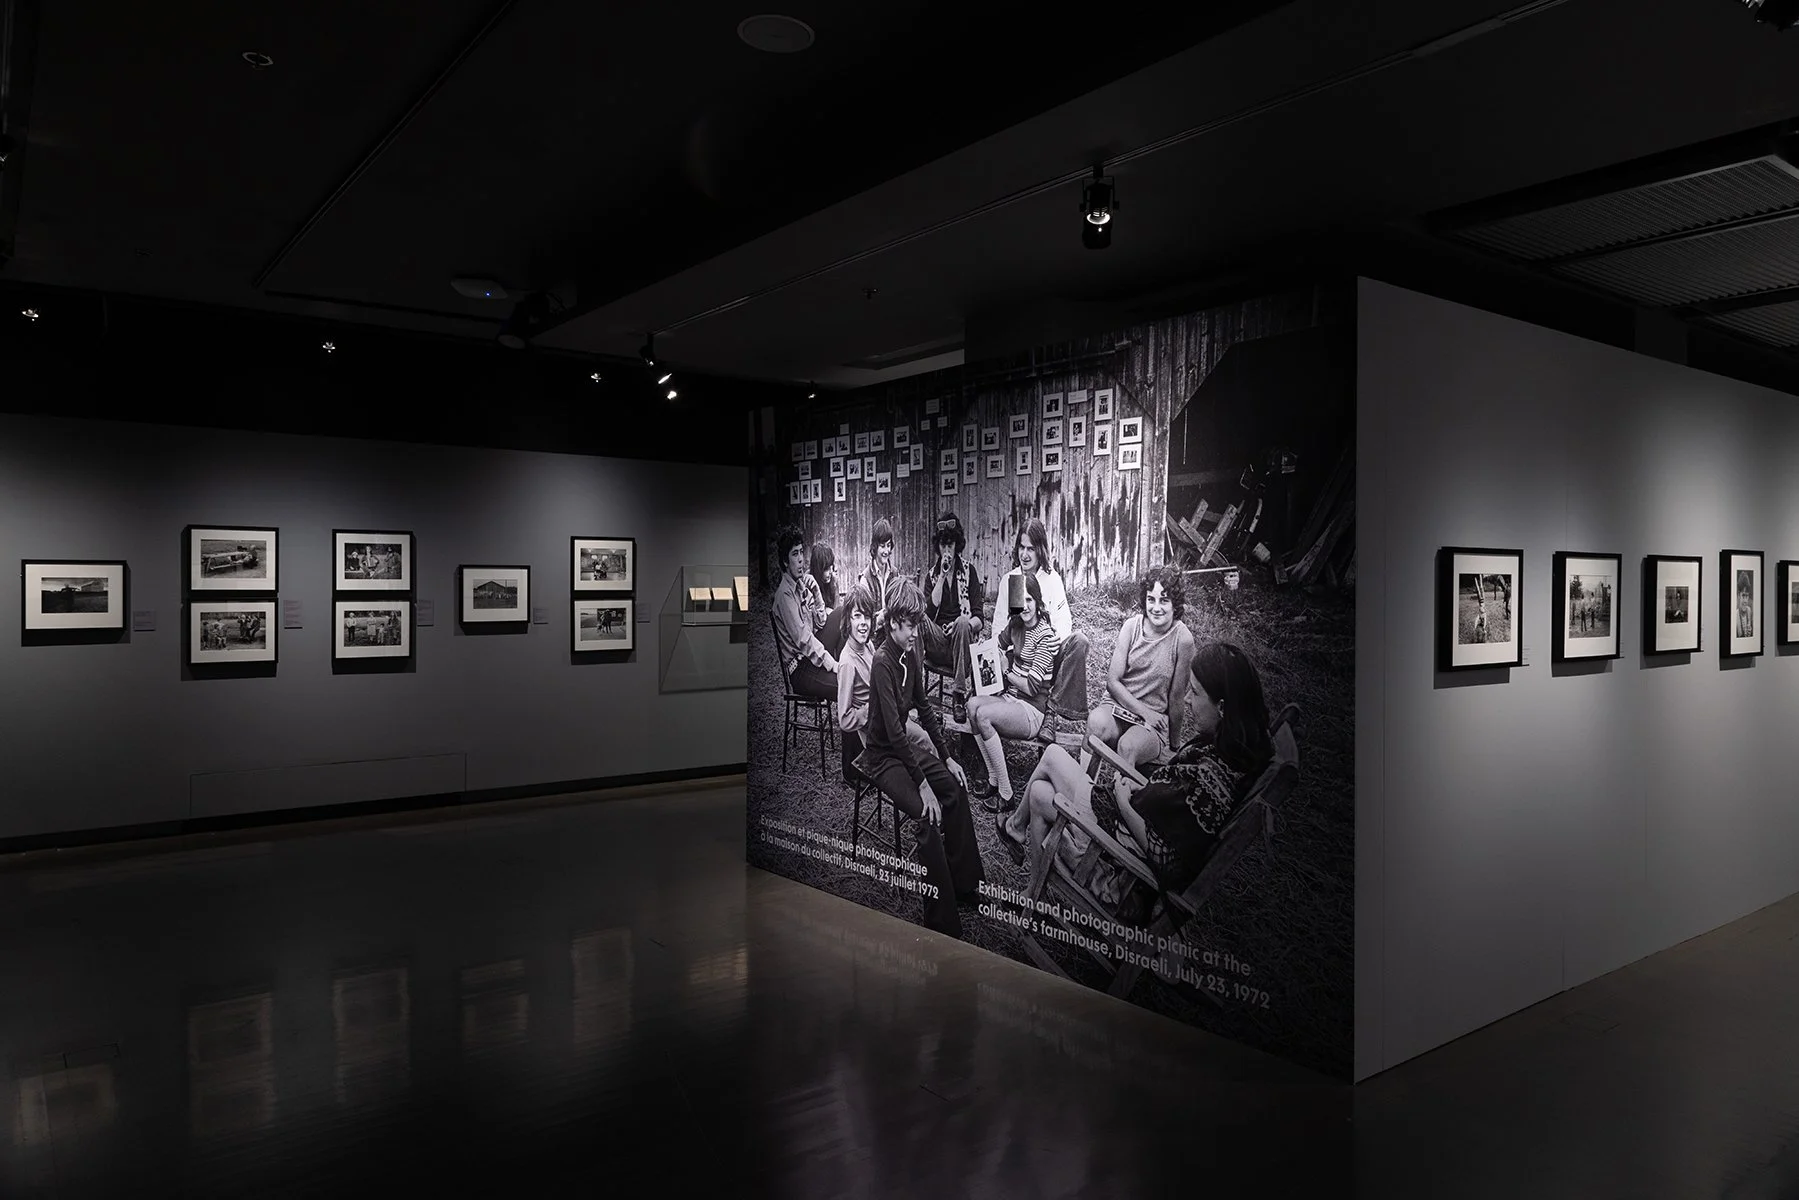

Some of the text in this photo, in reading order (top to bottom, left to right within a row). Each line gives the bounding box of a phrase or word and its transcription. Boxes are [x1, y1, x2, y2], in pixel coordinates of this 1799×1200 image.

[766, 832, 774, 844] la
[774, 836, 801, 853] maison
[801, 843, 811, 856] du
[811, 848, 844, 869] collectif,
[844, 855, 878, 880] Disraeli,
[879, 868, 890, 883] 23
[890, 871, 917, 892] juillet
[917, 881, 940, 900] 1972
[797, 826, 806, 838] et
[806, 829, 854, 853] pique-nique
[855, 843, 929, 877] photographique
[978, 879, 1251, 977] Exhibition and photographic picnic at the
[978, 903, 1270, 1010] collective's farmhouse, Disraeli, July 23, 1972
